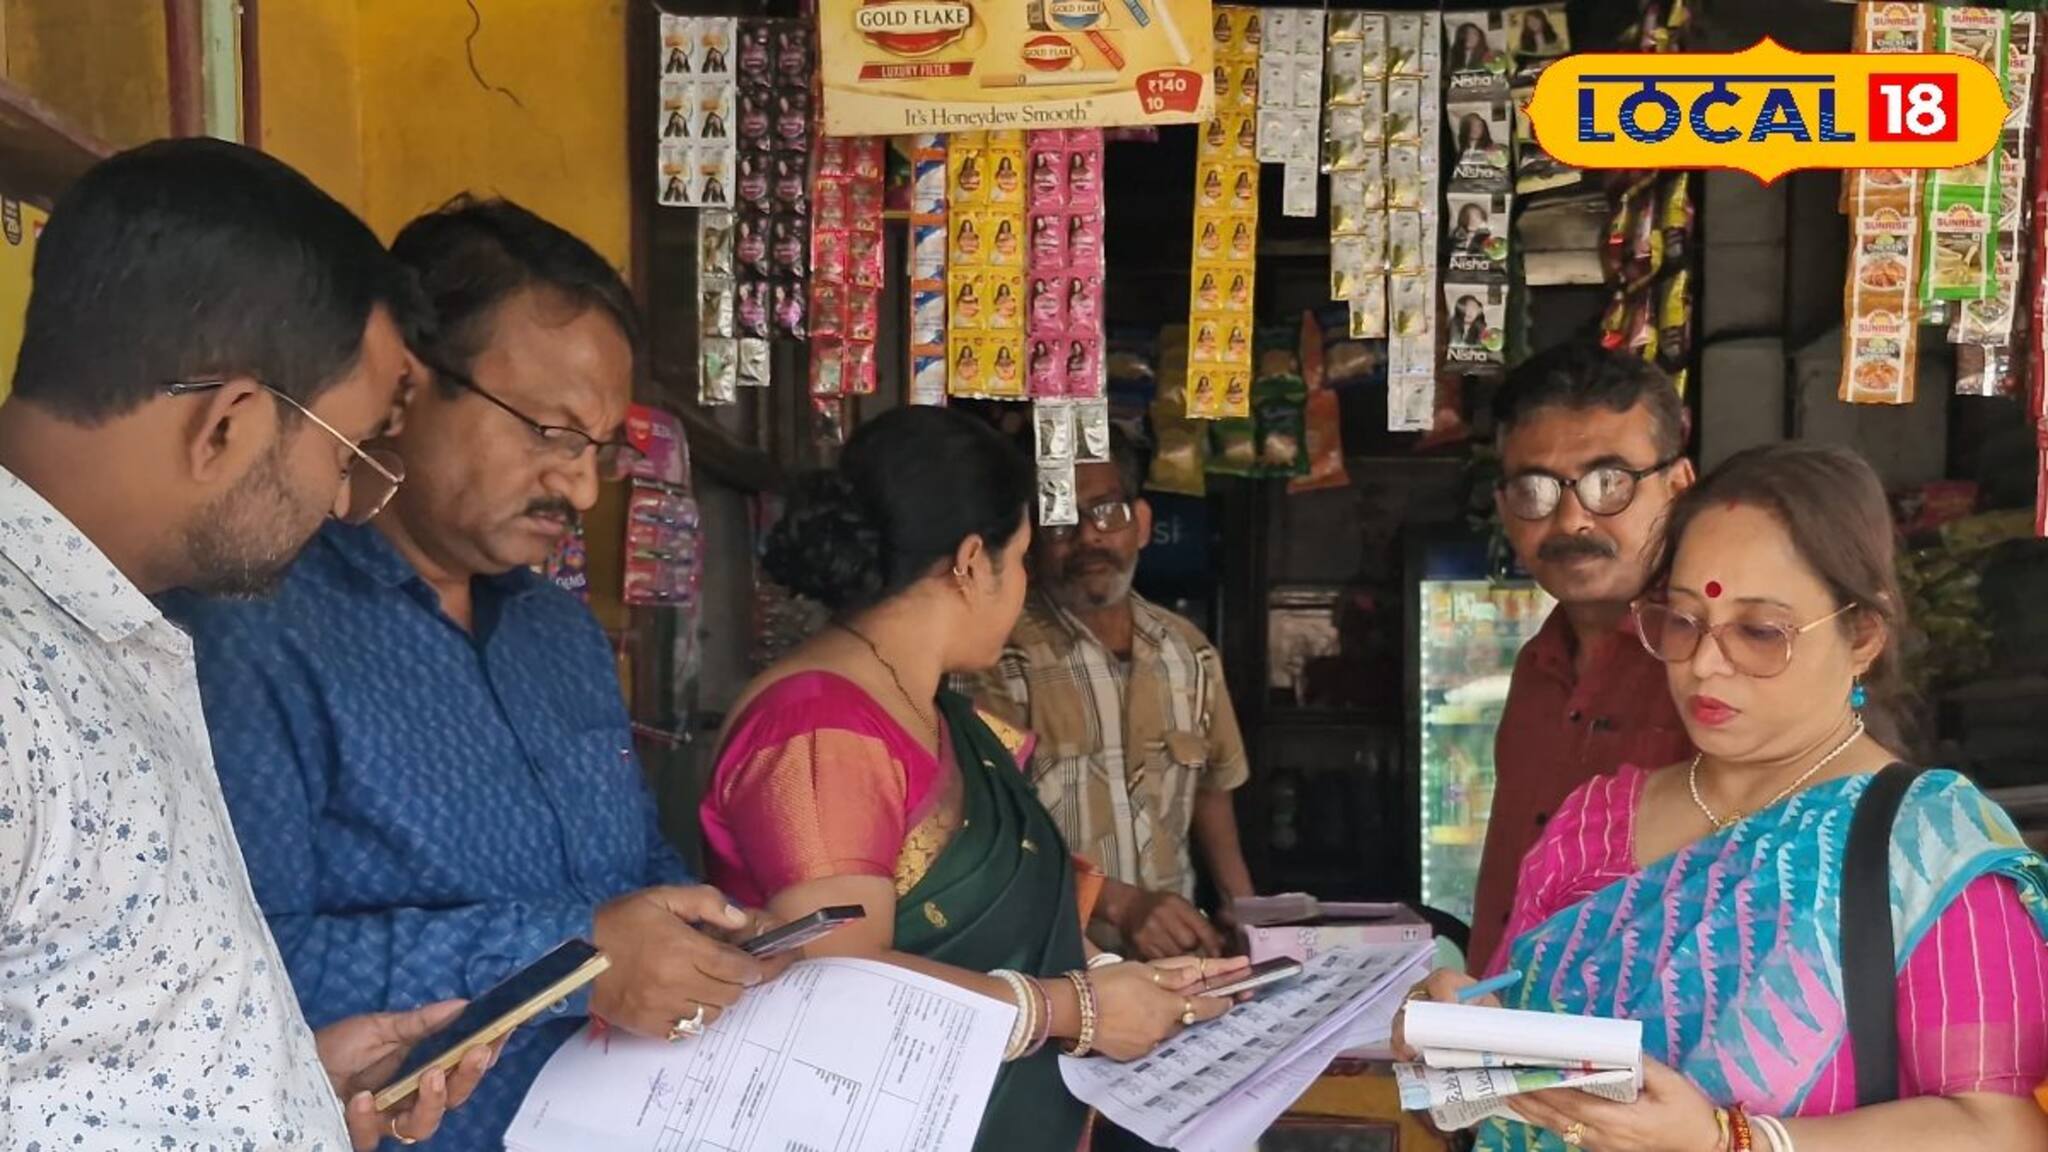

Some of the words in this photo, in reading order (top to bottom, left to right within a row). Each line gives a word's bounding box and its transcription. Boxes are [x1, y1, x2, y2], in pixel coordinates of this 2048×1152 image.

[1052, 3, 1074, 12] GOLD
[860, 11, 907, 27] GOLD
[914, 9, 966, 25] FLAKE
[1872, 17, 1918, 26] SUNRISE
[1951, 14, 1997, 25] SUNRISE
[881, 65, 918, 78] LUXURY
[921, 64, 951, 76] FILTER
[1148, 79, 1187, 93] ₹140
[1451, 76, 1491, 88] Nisha
[1146, 97, 1164, 110] 10
[905, 108, 928, 126] It's
[932, 107, 1018, 127] Honeydew
[1453, 166, 1494, 178] Nisha
[1863, 221, 1909, 230] SUNRISE
[1936, 217, 1983, 227] SUNRISE
[1450, 256, 1490, 270] Nisha
[1858, 323, 1900, 333] SUNRISE
[1447, 348, 1487, 361] Nisha
